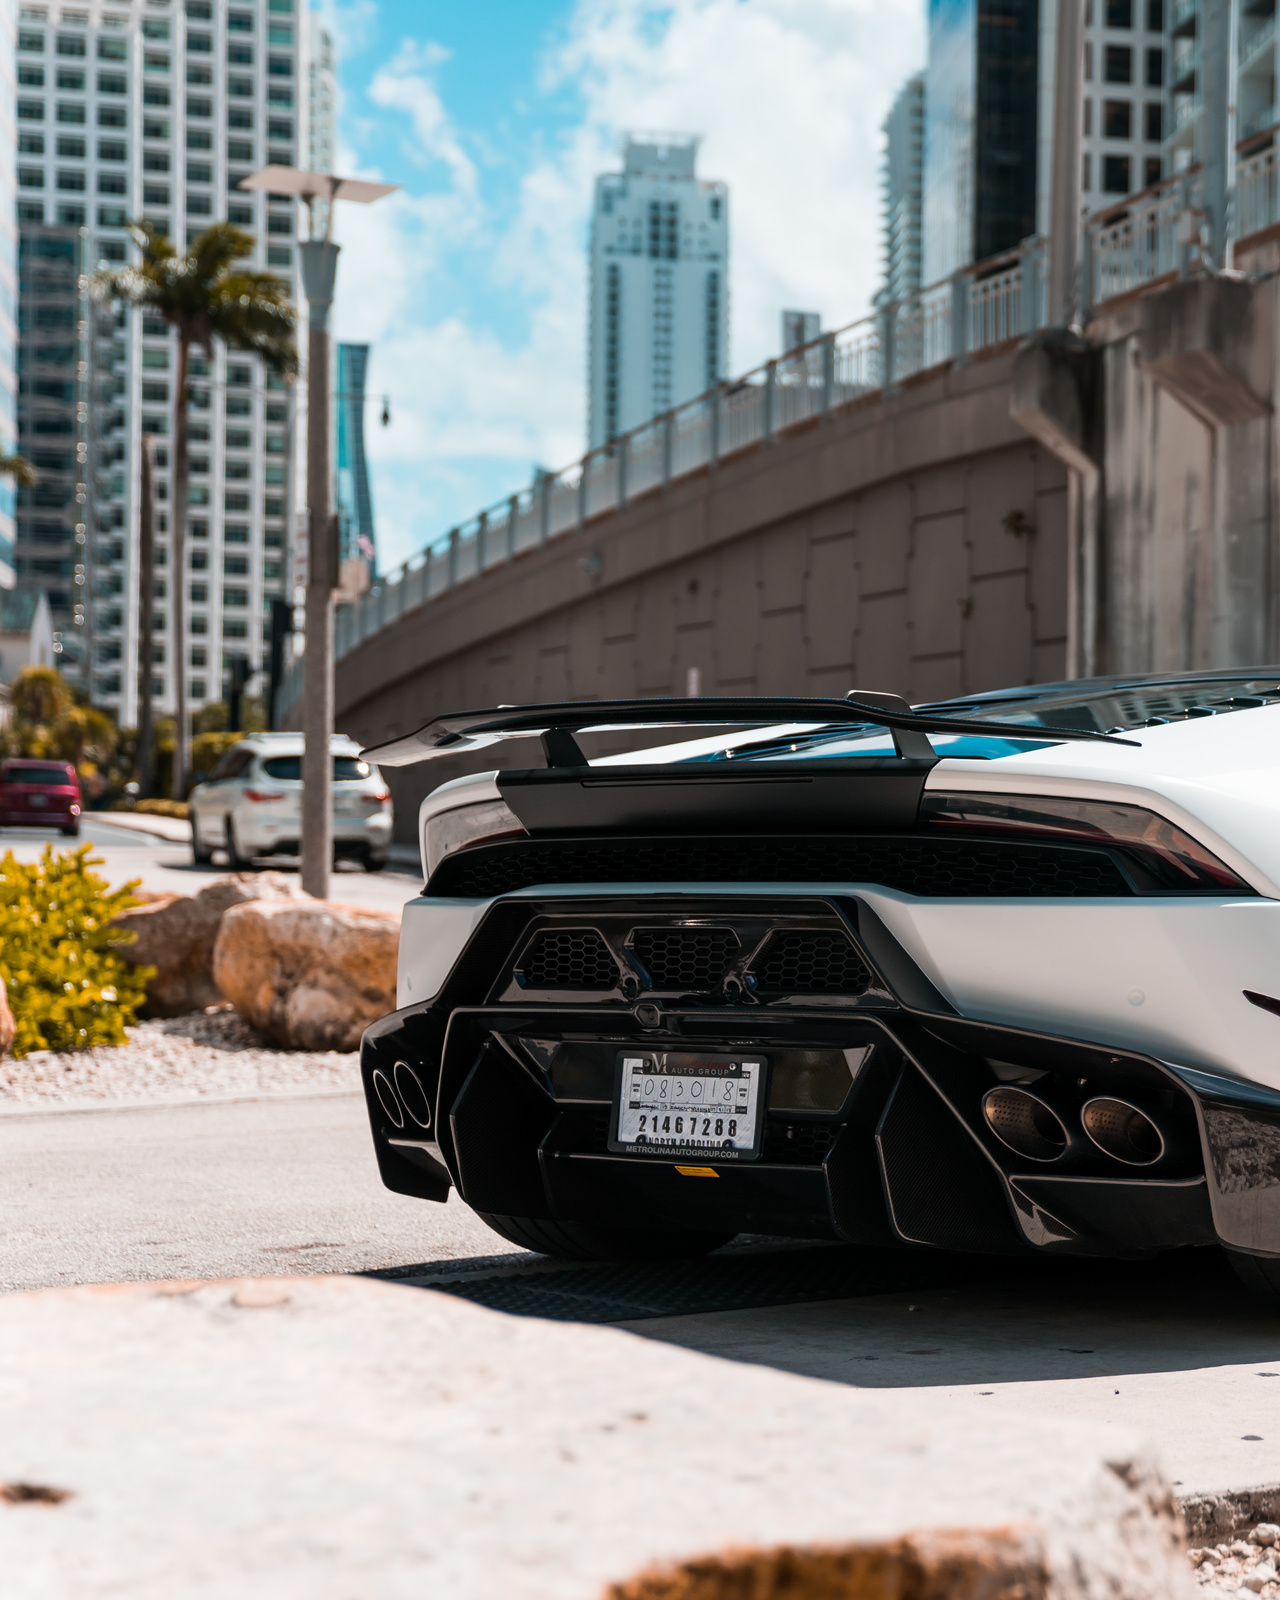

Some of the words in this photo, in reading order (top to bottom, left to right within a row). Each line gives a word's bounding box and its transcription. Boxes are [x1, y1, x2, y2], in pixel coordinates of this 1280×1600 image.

[671, 1067, 694, 1075] AUTO
[698, 1069, 729, 1077] GROUP
[638, 1114, 738, 1137] 21467288
[625, 1145, 739, 1159] METROLINAAUTOGROUP.COM
